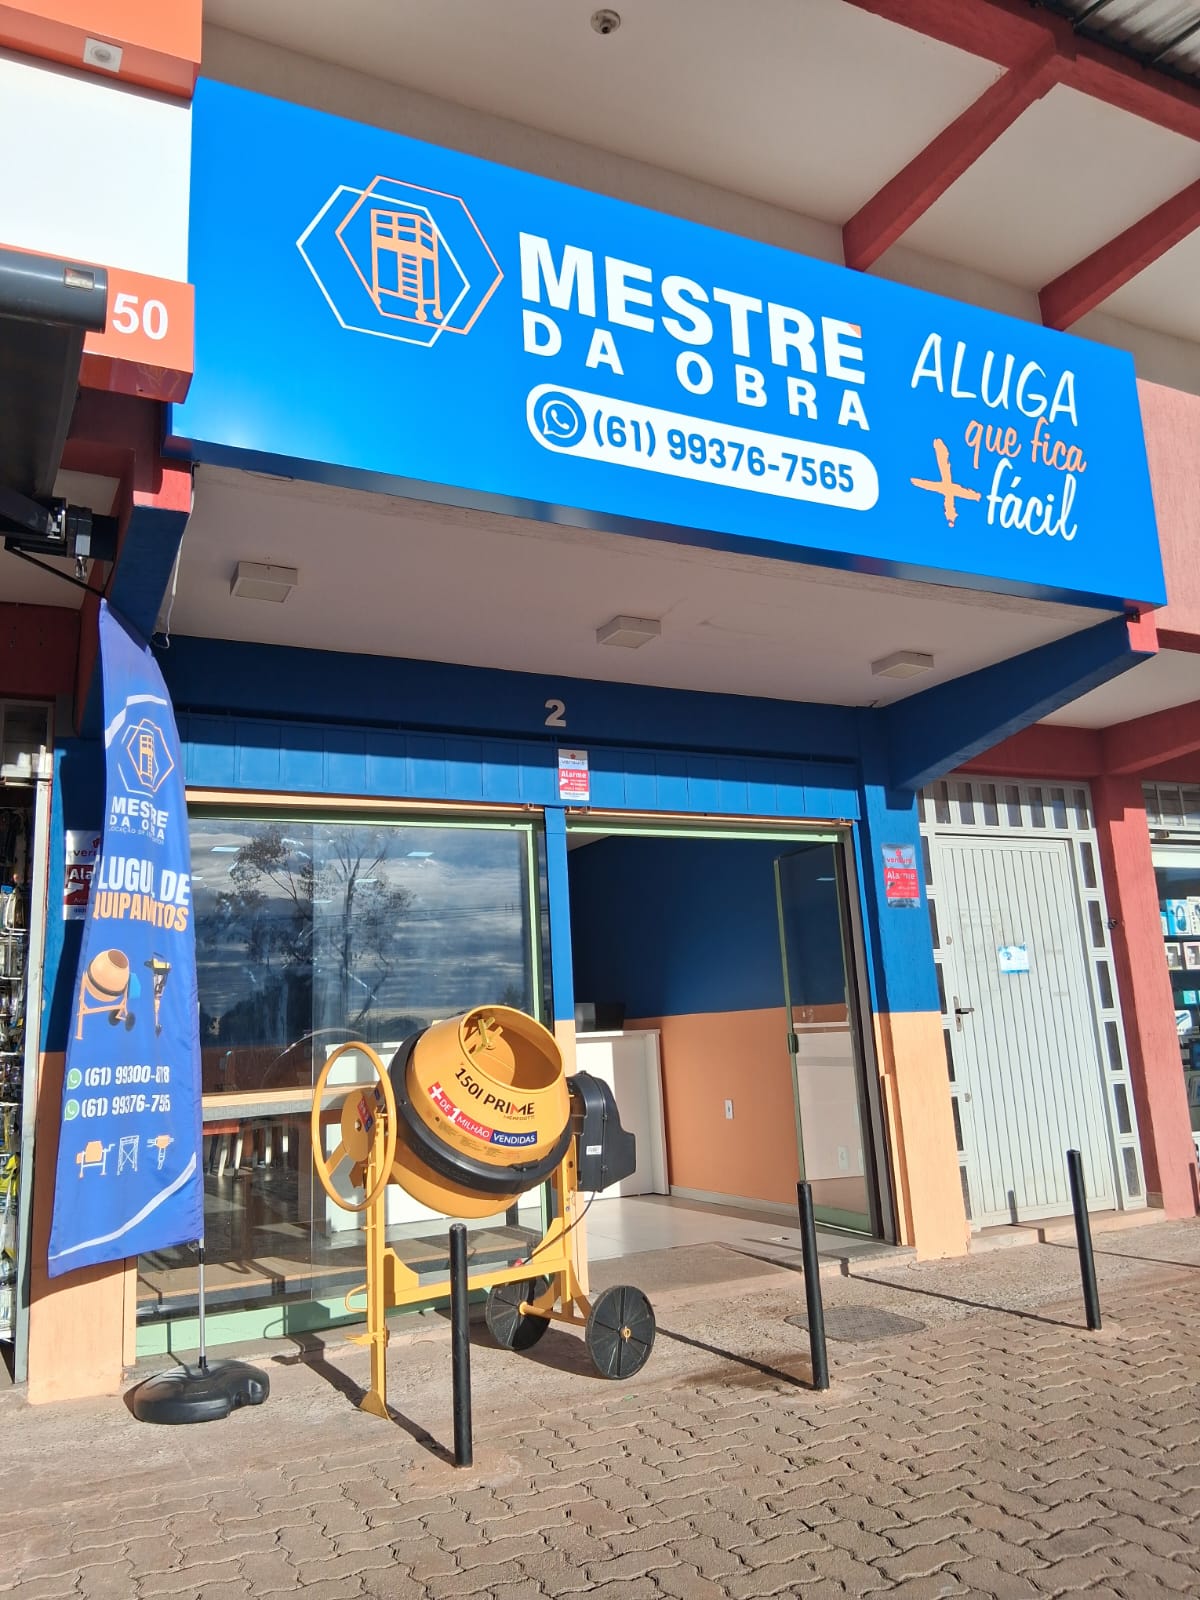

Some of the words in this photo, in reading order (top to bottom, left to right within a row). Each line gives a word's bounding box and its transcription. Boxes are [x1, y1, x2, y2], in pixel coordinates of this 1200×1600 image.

[112, 292, 168, 340] 50
[518, 230, 866, 385] MESTRE
[522, 308, 625, 376] DA
[675, 350, 871, 431] OBRA
[910, 332, 1078, 427] ALUGA
[593, 409, 656, 458] (61)
[667, 428, 855, 493] 99376-7565
[965, 419, 1022, 470] que
[1030, 416, 1088, 473] fica
[986, 457, 1078, 541] fácil
[544, 699, 567, 727] 2
[160, 869, 191, 906] DE
[84, 1067, 111, 1086] (61)
[81, 1098, 108, 1118] (61)
[439, 1098, 452, 1113] DE
[447, 1106, 462, 1124] 1
[456, 1115, 491, 1139] MILHÃO
[494, 1133, 536, 1144] VENDIDAS
[483, 1093, 536, 1116] PRIME
